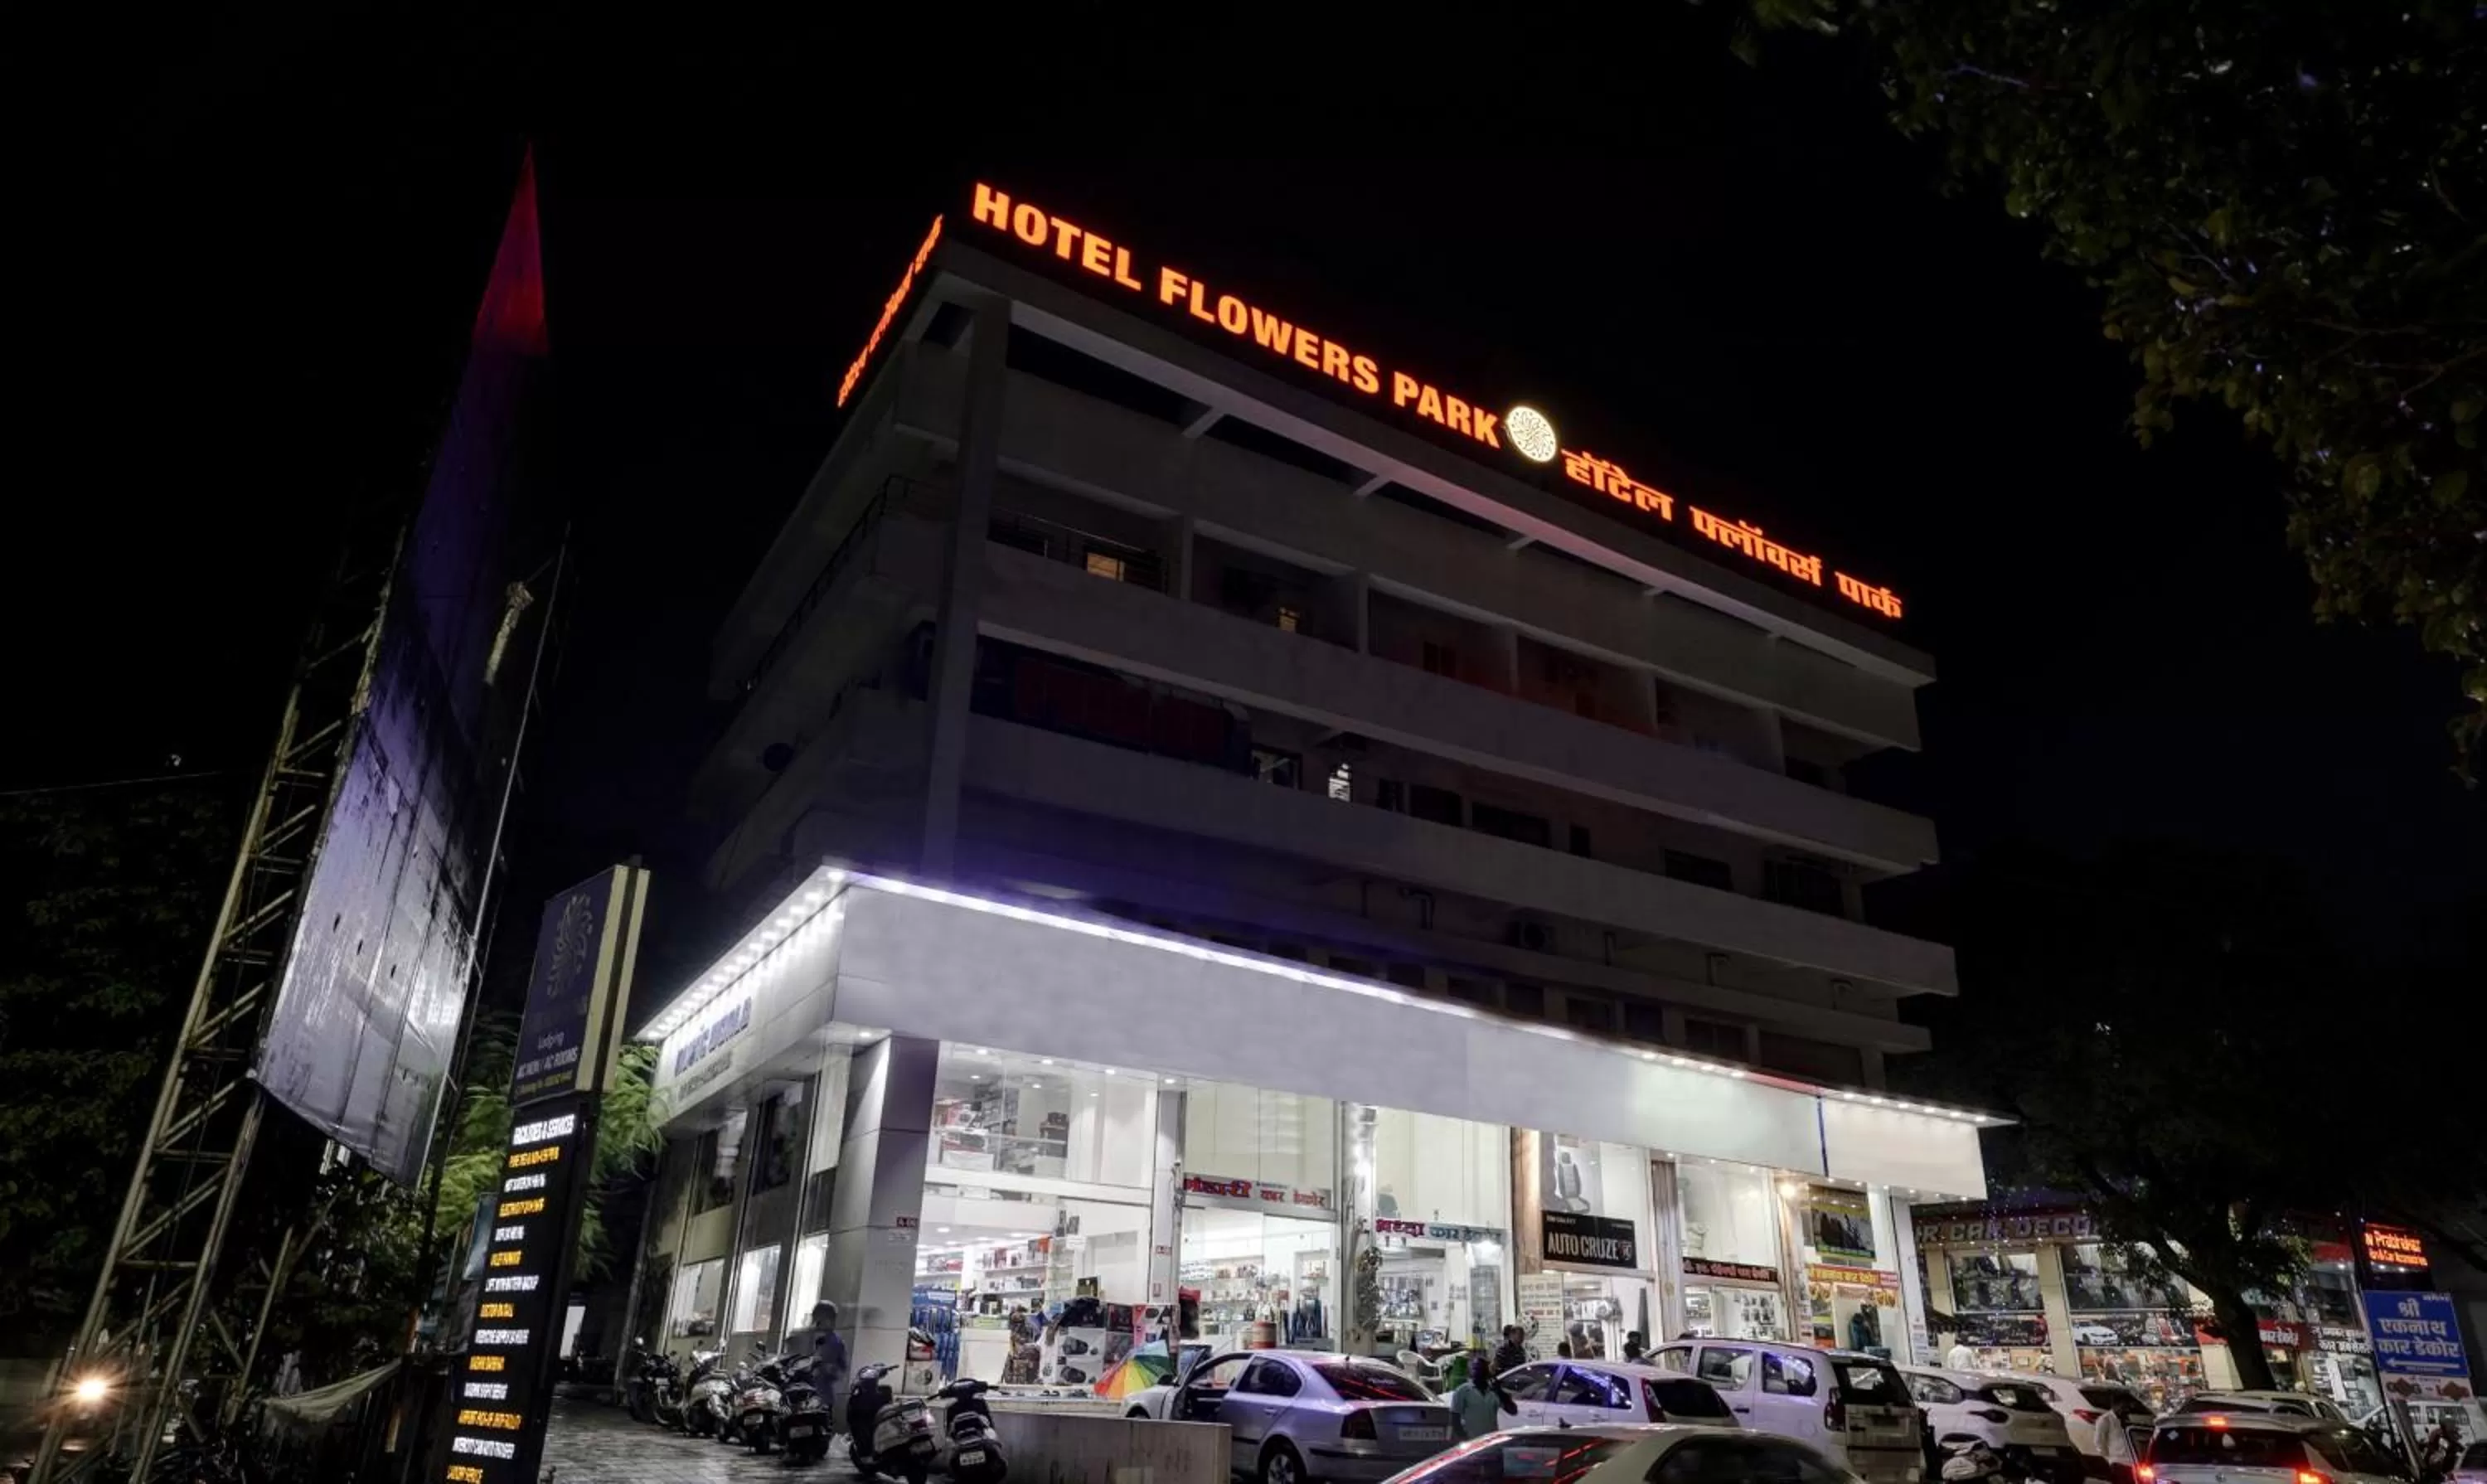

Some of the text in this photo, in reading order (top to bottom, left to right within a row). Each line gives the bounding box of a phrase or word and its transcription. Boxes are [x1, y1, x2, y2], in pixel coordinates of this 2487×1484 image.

[972, 183, 1500, 448] HOTEL FLOWERS PARK
[1835, 571, 1903, 618] पार्क
[1548, 1232, 1619, 1261] AUTO CRUZE
[2397, 1297, 2421, 1317] श्री
[2377, 1318, 2447, 1336] एकनाथ
[2375, 1337, 2412, 1355] कार
[2412, 1336, 2460, 1358] डेकोर
